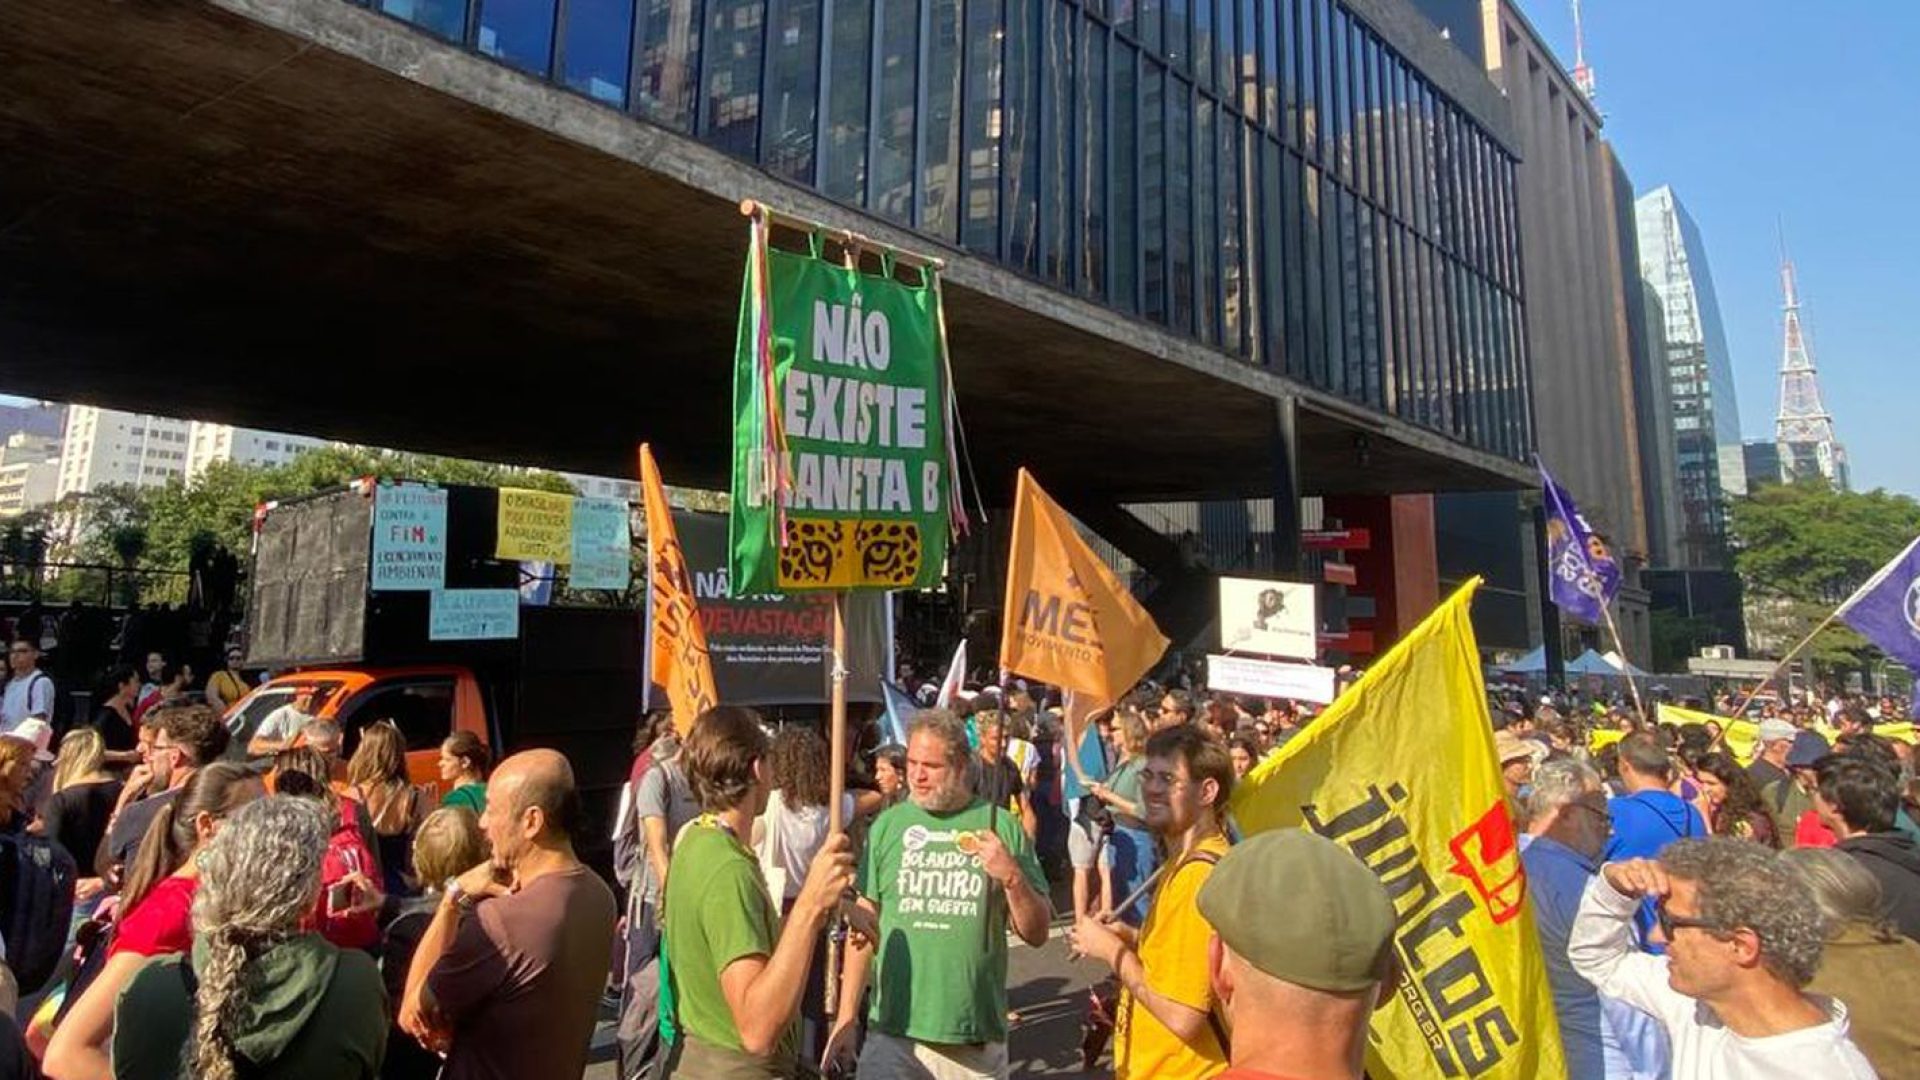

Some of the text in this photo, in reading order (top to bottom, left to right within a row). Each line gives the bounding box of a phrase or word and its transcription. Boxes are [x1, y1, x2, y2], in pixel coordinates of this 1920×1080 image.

[813, 292, 890, 370] NÃO
[785, 370, 926, 448] EXISTE
[923, 460, 941, 512] B
[391, 525, 425, 543] FIM
[695, 566, 744, 600] NÃ
[901, 850, 983, 868] BOLANDO O
[897, 869, 983, 898] FUTURO
